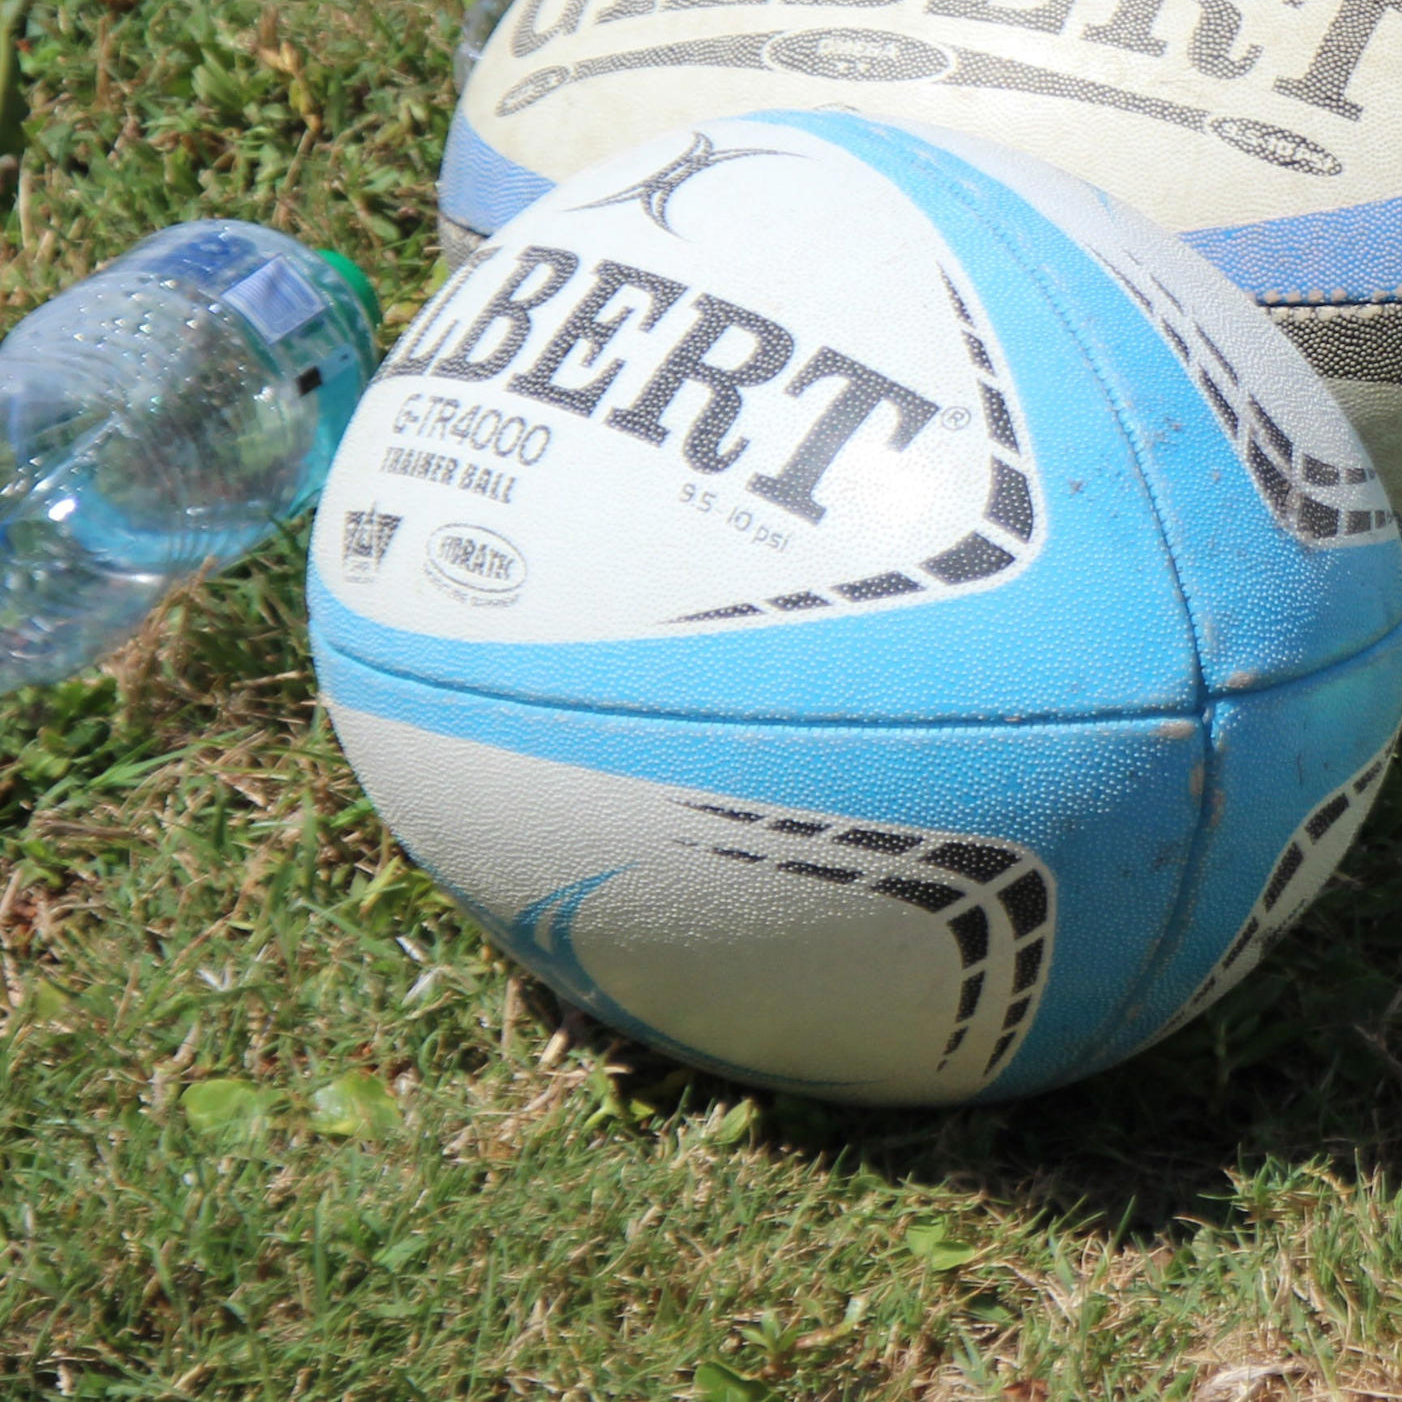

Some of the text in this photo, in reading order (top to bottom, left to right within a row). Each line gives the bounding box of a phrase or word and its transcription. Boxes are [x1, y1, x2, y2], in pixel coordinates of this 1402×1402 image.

[375, 244, 941, 526] LBERT
[382, 445, 518, 505] TRAINER BALL
[750, 521, 793, 554] psi
